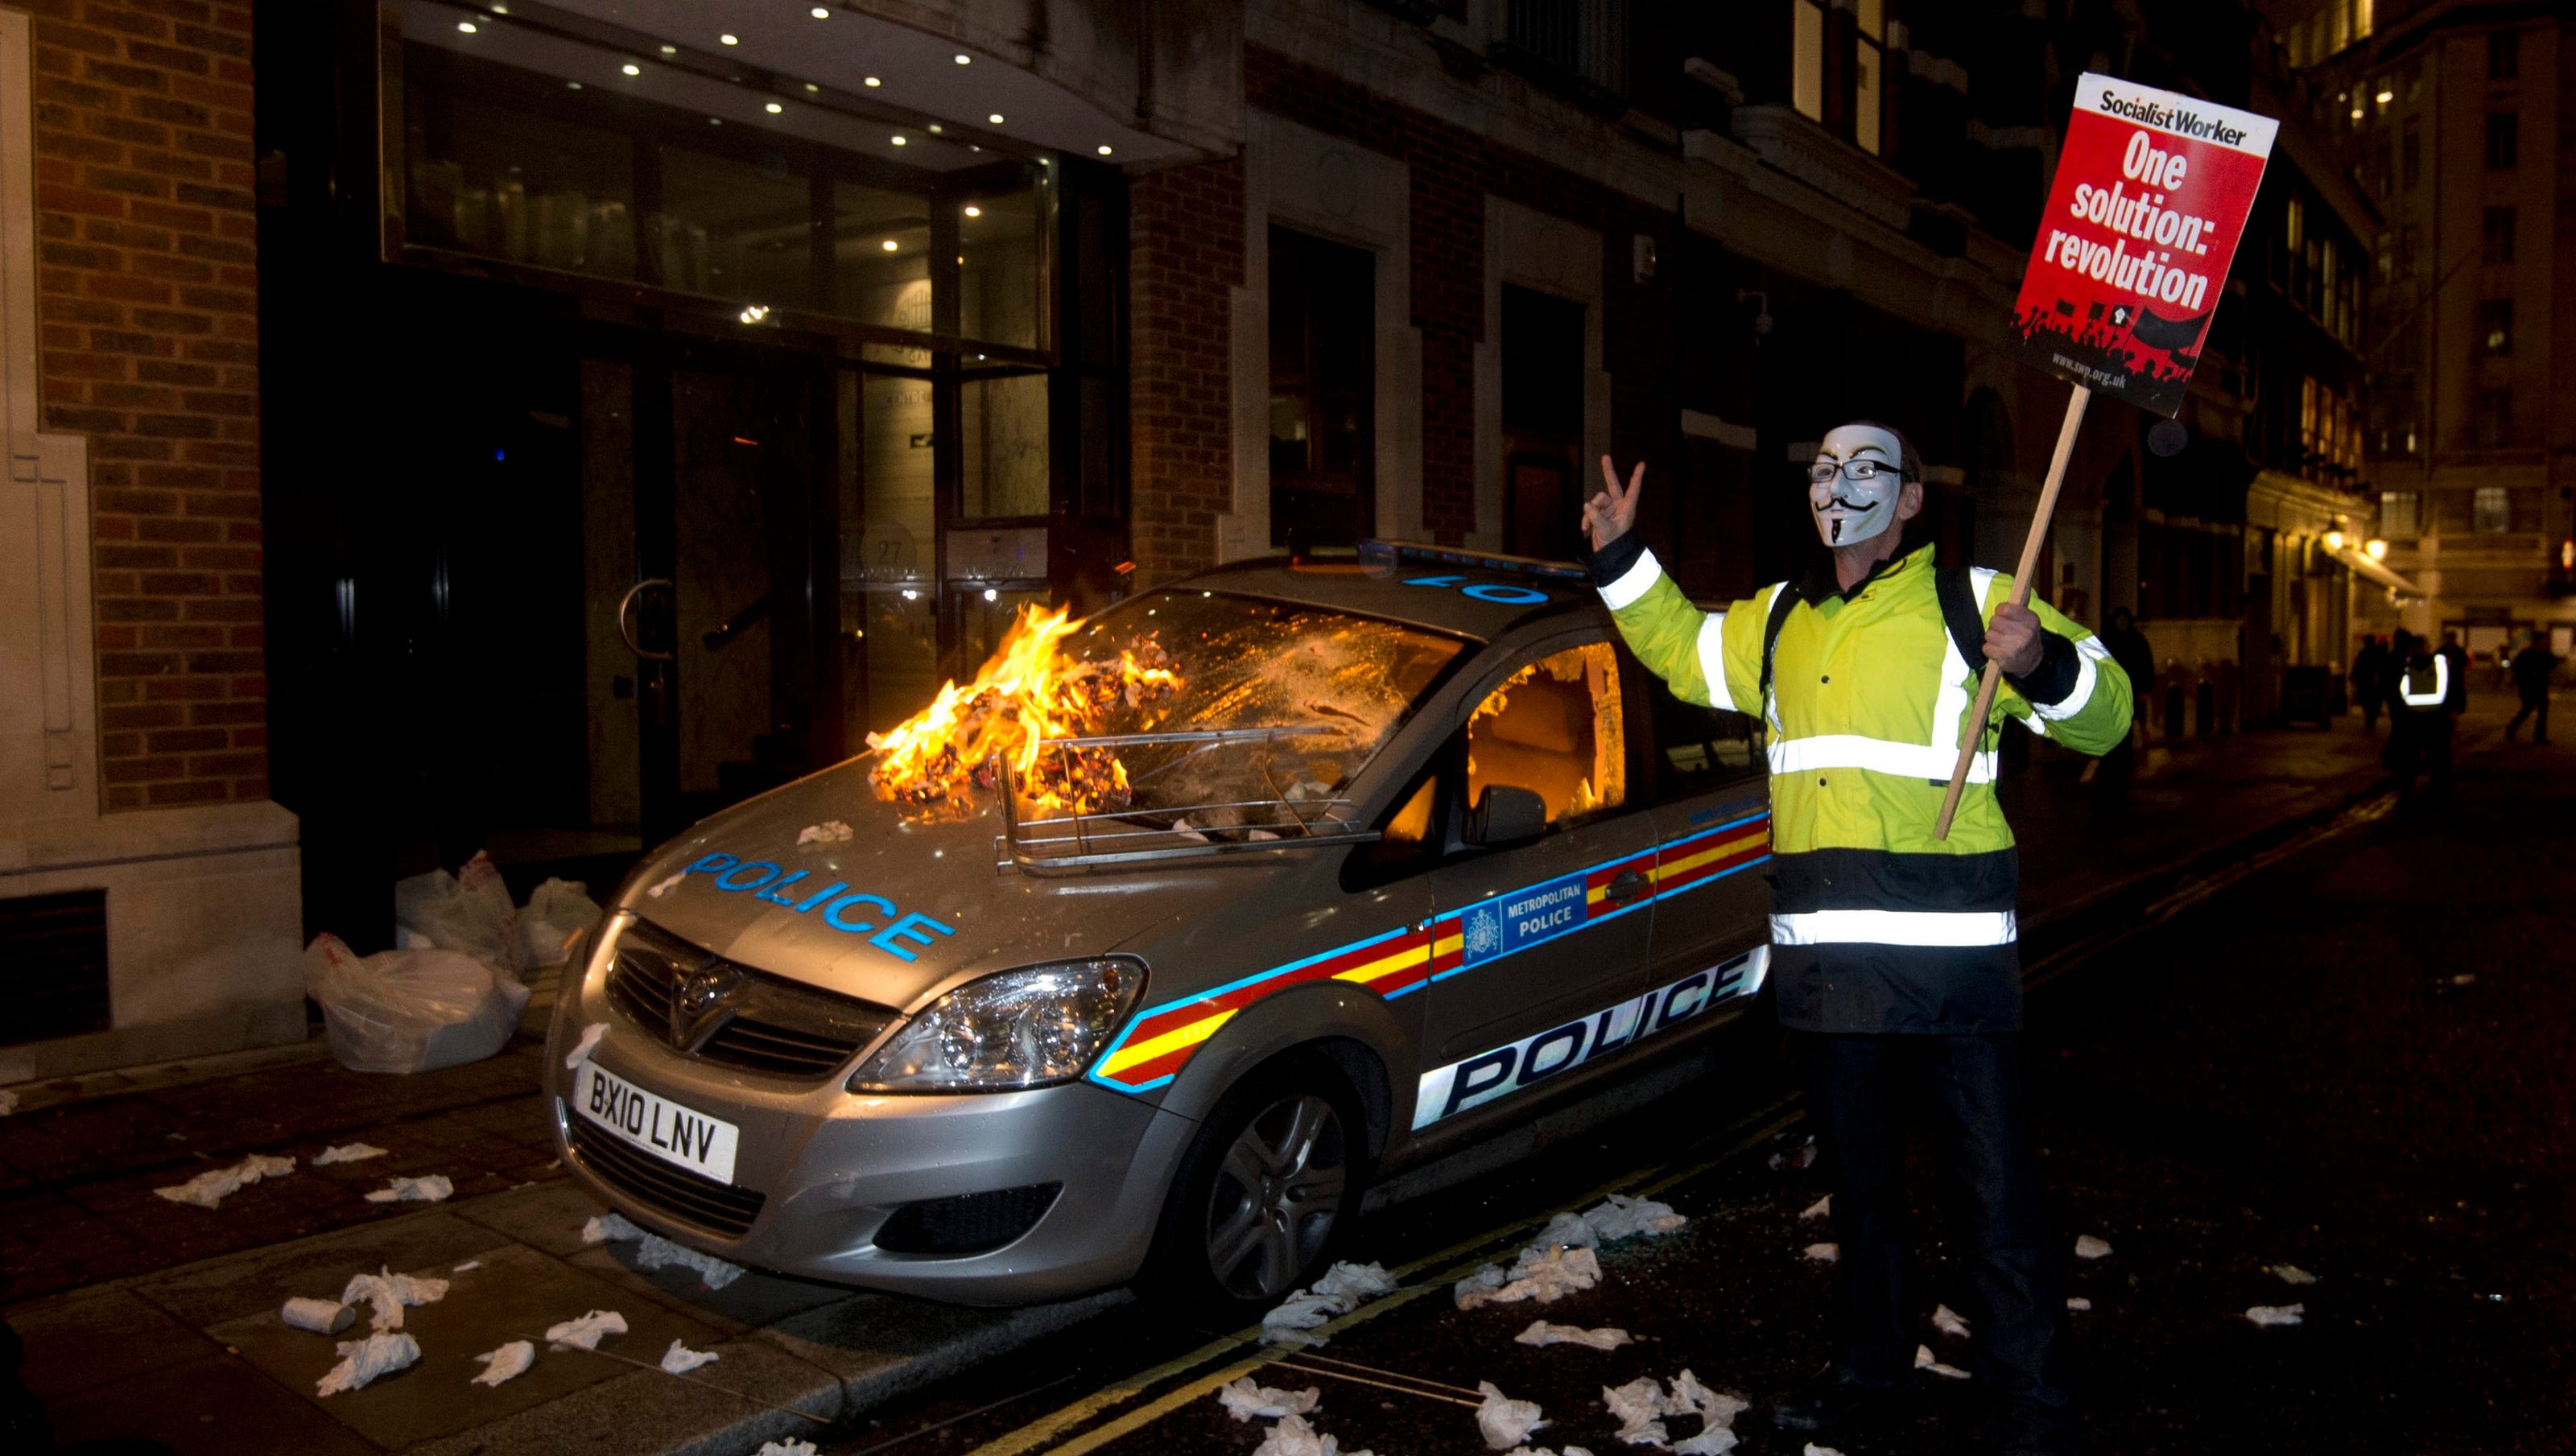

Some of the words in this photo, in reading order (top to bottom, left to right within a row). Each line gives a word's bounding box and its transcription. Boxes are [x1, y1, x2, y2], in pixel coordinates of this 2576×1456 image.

[2100, 90, 2174, 130] Socialist
[2175, 109, 2247, 146] Worker
[2123, 130, 2187, 190] One
[2070, 181, 2215, 255] solution:
[2045, 229, 2208, 311] revolution
[2053, 353, 2126, 388] www.swp.org.uk
[685, 852, 956, 963] POLICE
[1508, 883, 1580, 918] METROPOLITAN
[1520, 906, 1571, 937] POLICE
[1440, 953, 1750, 1119] POLICE
[590, 1070, 645, 1136] BX10
[651, 1102, 716, 1164] LNV
